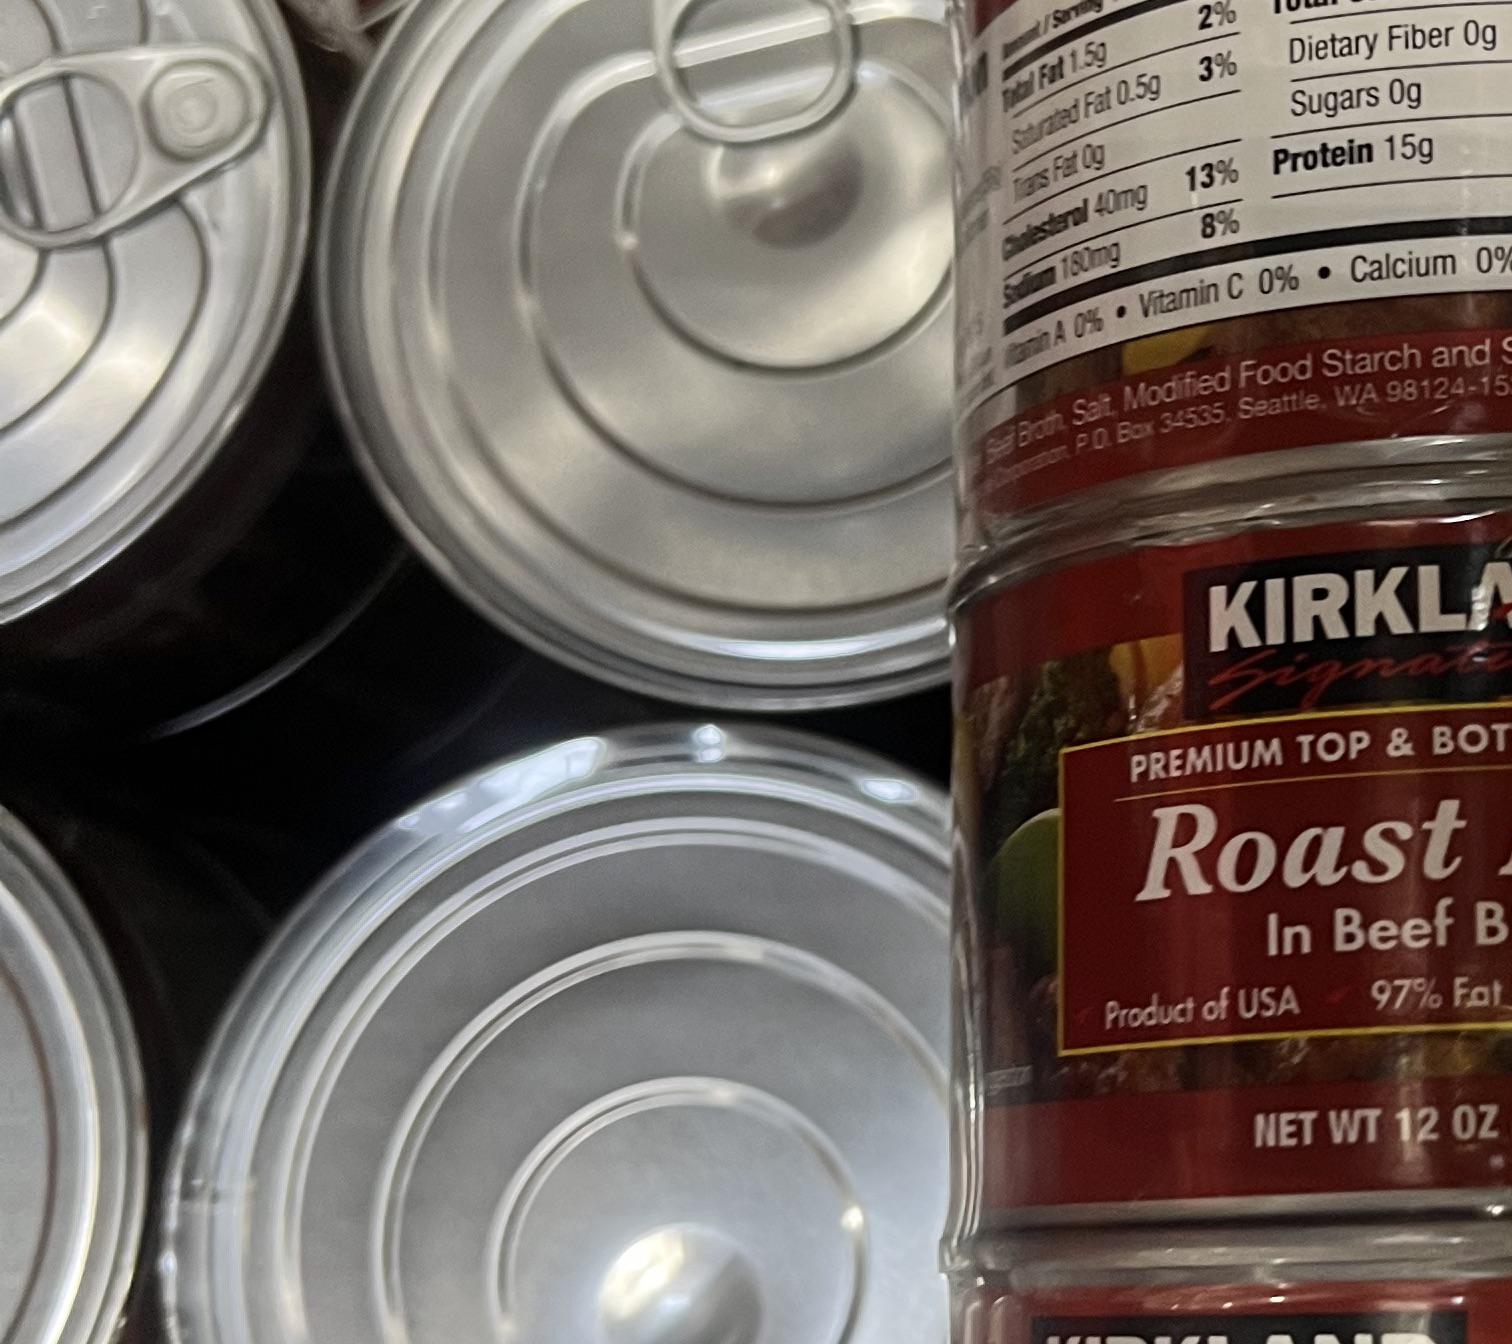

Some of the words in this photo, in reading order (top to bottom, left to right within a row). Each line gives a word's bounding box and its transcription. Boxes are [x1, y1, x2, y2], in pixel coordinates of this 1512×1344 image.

[1038, 54, 1065, 92] Fat
[1069, 41, 1108, 74] 1.5g
[1197, 0, 1238, 32] 2%
[1288, 31, 1379, 65] Dietary
[1387, 22, 1455, 52] Fiber
[1463, 19, 1498, 52] 0g
[1083, 86, 1112, 120] Fat
[1116, 72, 1162, 107] 0.5g
[1198, 50, 1238, 83] 3%
[1289, 83, 1381, 119] Sugars
[1388, 77, 1423, 110] 0g
[1052, 150, 1079, 183] Fat
[1081, 143, 1106, 172] 0g
[1271, 138, 1375, 177] Protein
[1383, 132, 1435, 165] 15g
[1093, 184, 1149, 217] 40mg
[1185, 156, 1240, 193] 13%
[1200, 207, 1241, 240] 8%
[1052, 319, 1068, 348] A
[1072, 311, 1105, 339] 0%
[1138, 278, 1220, 318] Vitamin
[1226, 272, 1245, 301] C
[1258, 264, 1302, 296] 0%
[1350, 250, 1457, 284] Calcium
[1122, 365, 1232, 414] Modified
[1238, 358, 1314, 390] Food
[1321, 341, 1423, 379] Starch
[1430, 337, 1493, 368] and
[1158, 402, 1231, 434] 34535,
[1334, 382, 1381, 408] WA
[1129, 736, 1284, 784] PREMIUM
[1297, 728, 1371, 763] TOP
[1386, 727, 1415, 757] &
[1134, 798, 1467, 904] Roast
[1266, 911, 1312, 958] In
[1333, 896, 1456, 953] Beef
[1104, 985, 1195, 1032] Product
[1201, 986, 1232, 1022] of
[1236, 986, 1301, 1021] USA
[1370, 976, 1444, 1012] 97%
[1452, 976, 1504, 1010] Fat
[1253, 1110, 1317, 1149] NET
[1327, 1106, 1383, 1146] WT
[1396, 1105, 1438, 1143] 12
[1450, 1101, 1500, 1139] OZ
